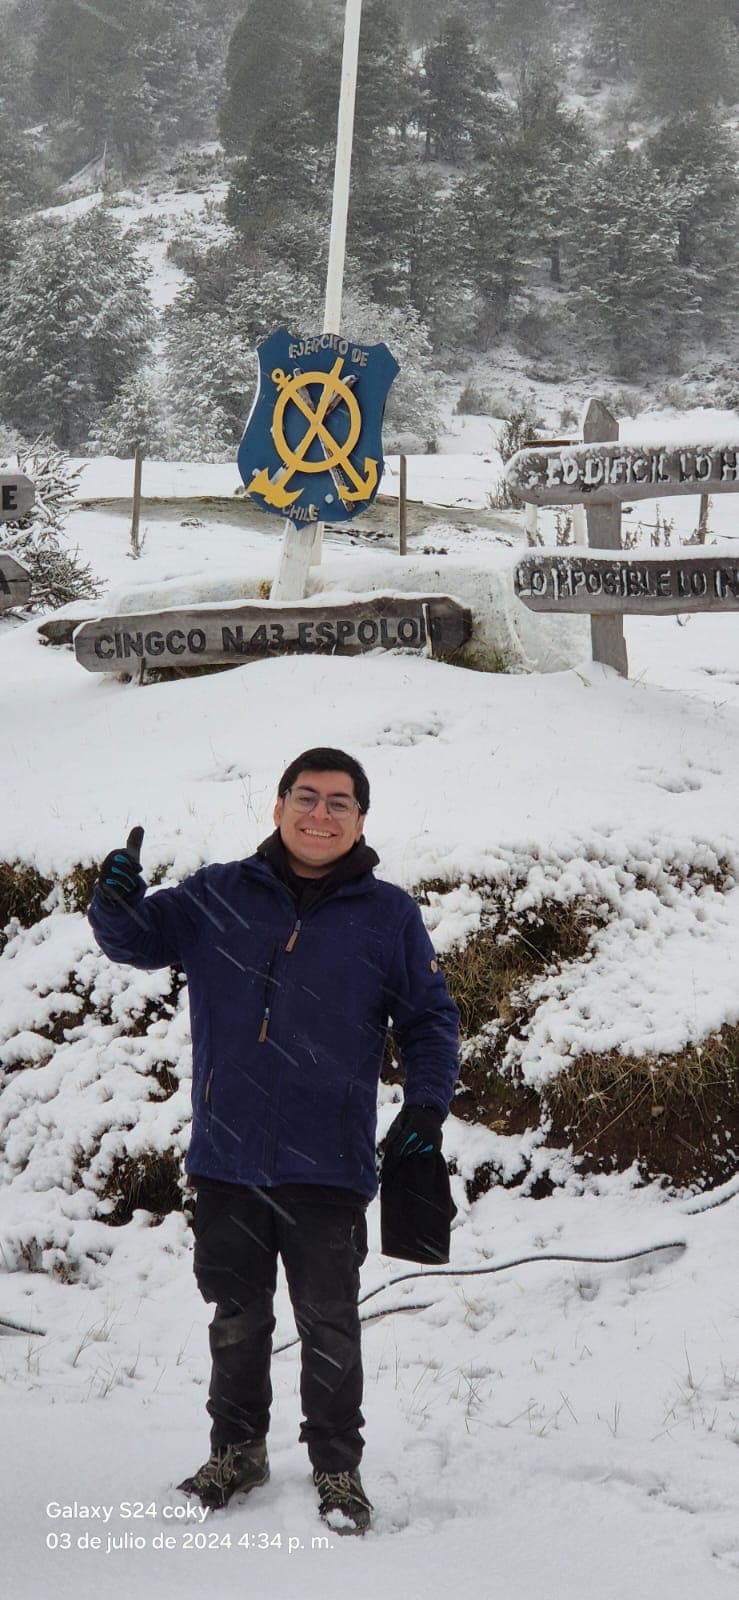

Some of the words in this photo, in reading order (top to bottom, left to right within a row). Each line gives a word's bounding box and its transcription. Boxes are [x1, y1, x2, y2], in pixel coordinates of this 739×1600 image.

[351, 348, 369, 367] DE
[680, 453, 712, 481] LO
[282, 503, 319, 521] CHILE
[517, 568, 547, 596] LO
[679, 569, 708, 598] LO
[95, 629, 206, 659] CINGCO
